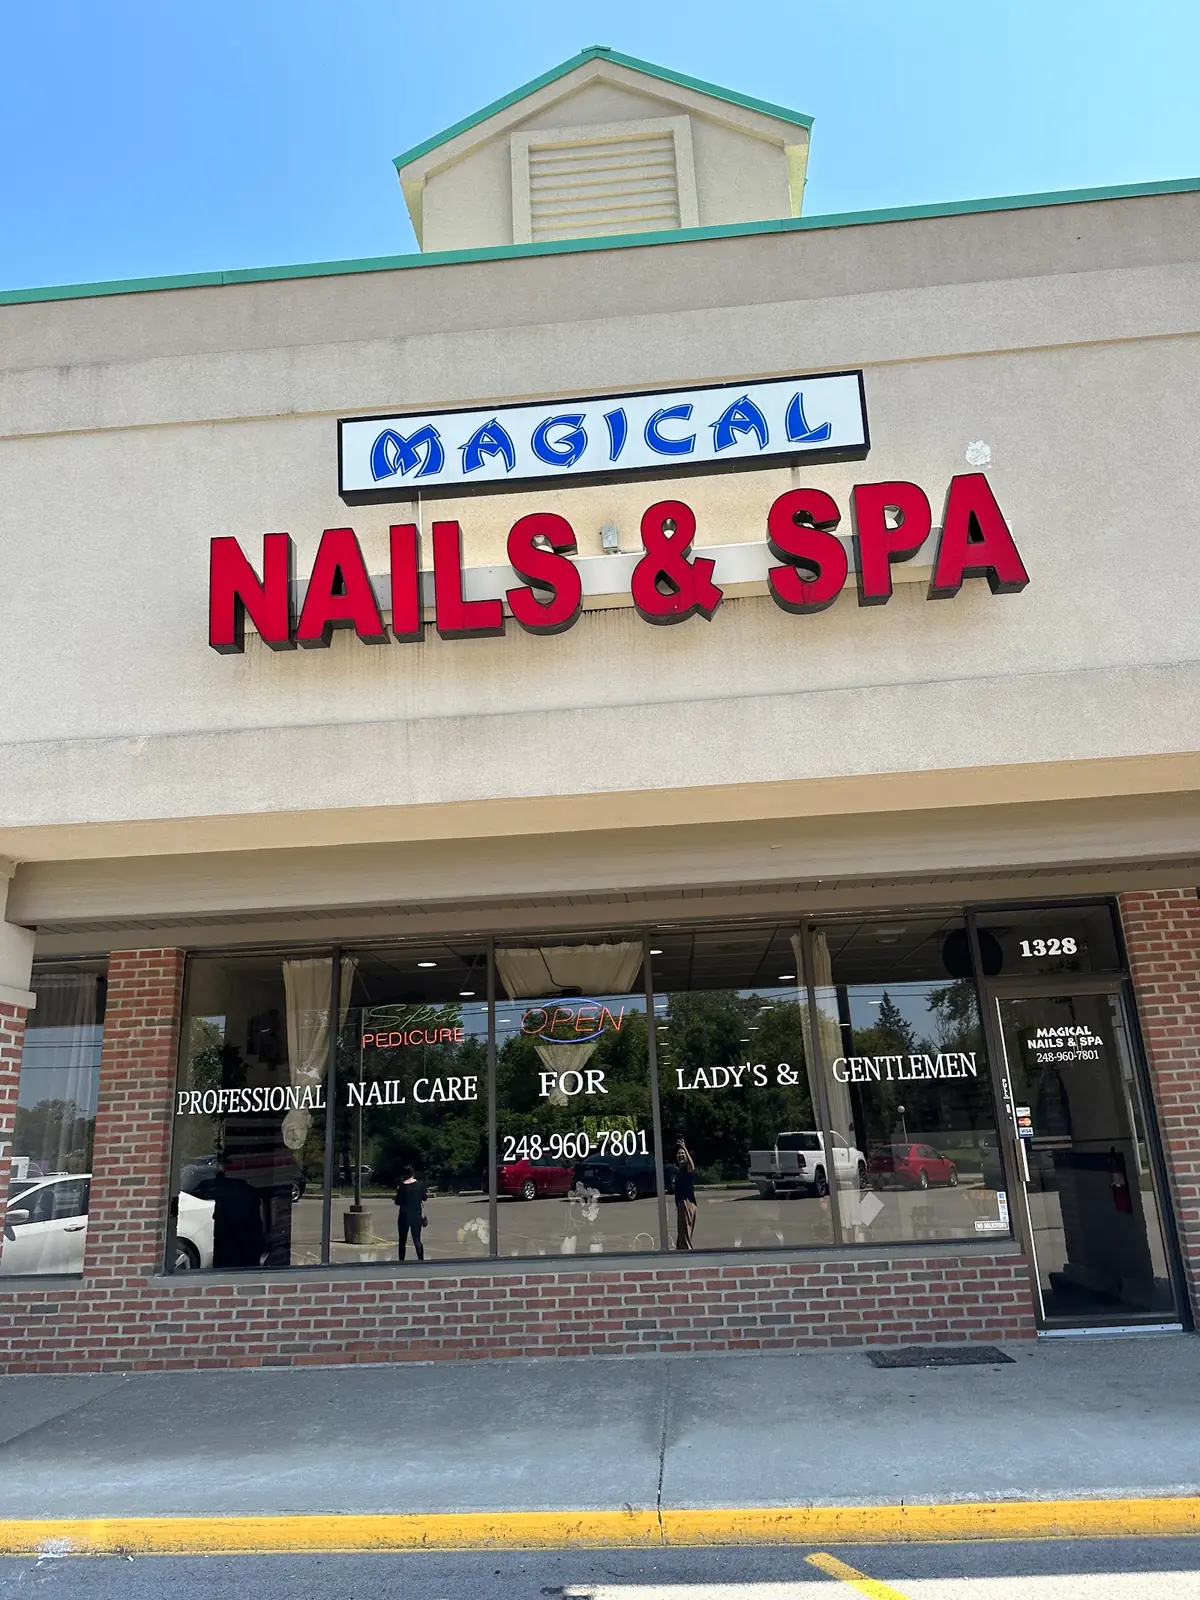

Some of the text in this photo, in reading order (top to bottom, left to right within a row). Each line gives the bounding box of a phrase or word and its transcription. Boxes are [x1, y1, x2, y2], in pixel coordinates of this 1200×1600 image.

[371, 391, 832, 482] MAGICAL
[209, 472, 1030, 653] NAILS & SPA
[1020, 938, 1078, 957] 1328
[362, 1004, 465, 1029] Spa
[521, 1005, 625, 1035] OPEN
[362, 1027, 465, 1049] PEDICURE
[1027, 1035, 1104, 1049] NAILS & SPA
[1036, 1025, 1092, 1037] MAGICAL
[1036, 1049, 1100, 1063] 248-960-7801
[177, 1052, 978, 1115] PROFESSIONAL NAIL CARE FOR LADY'S & GENTLEMEN
[503, 1129, 649, 1161] 248-960-7801
